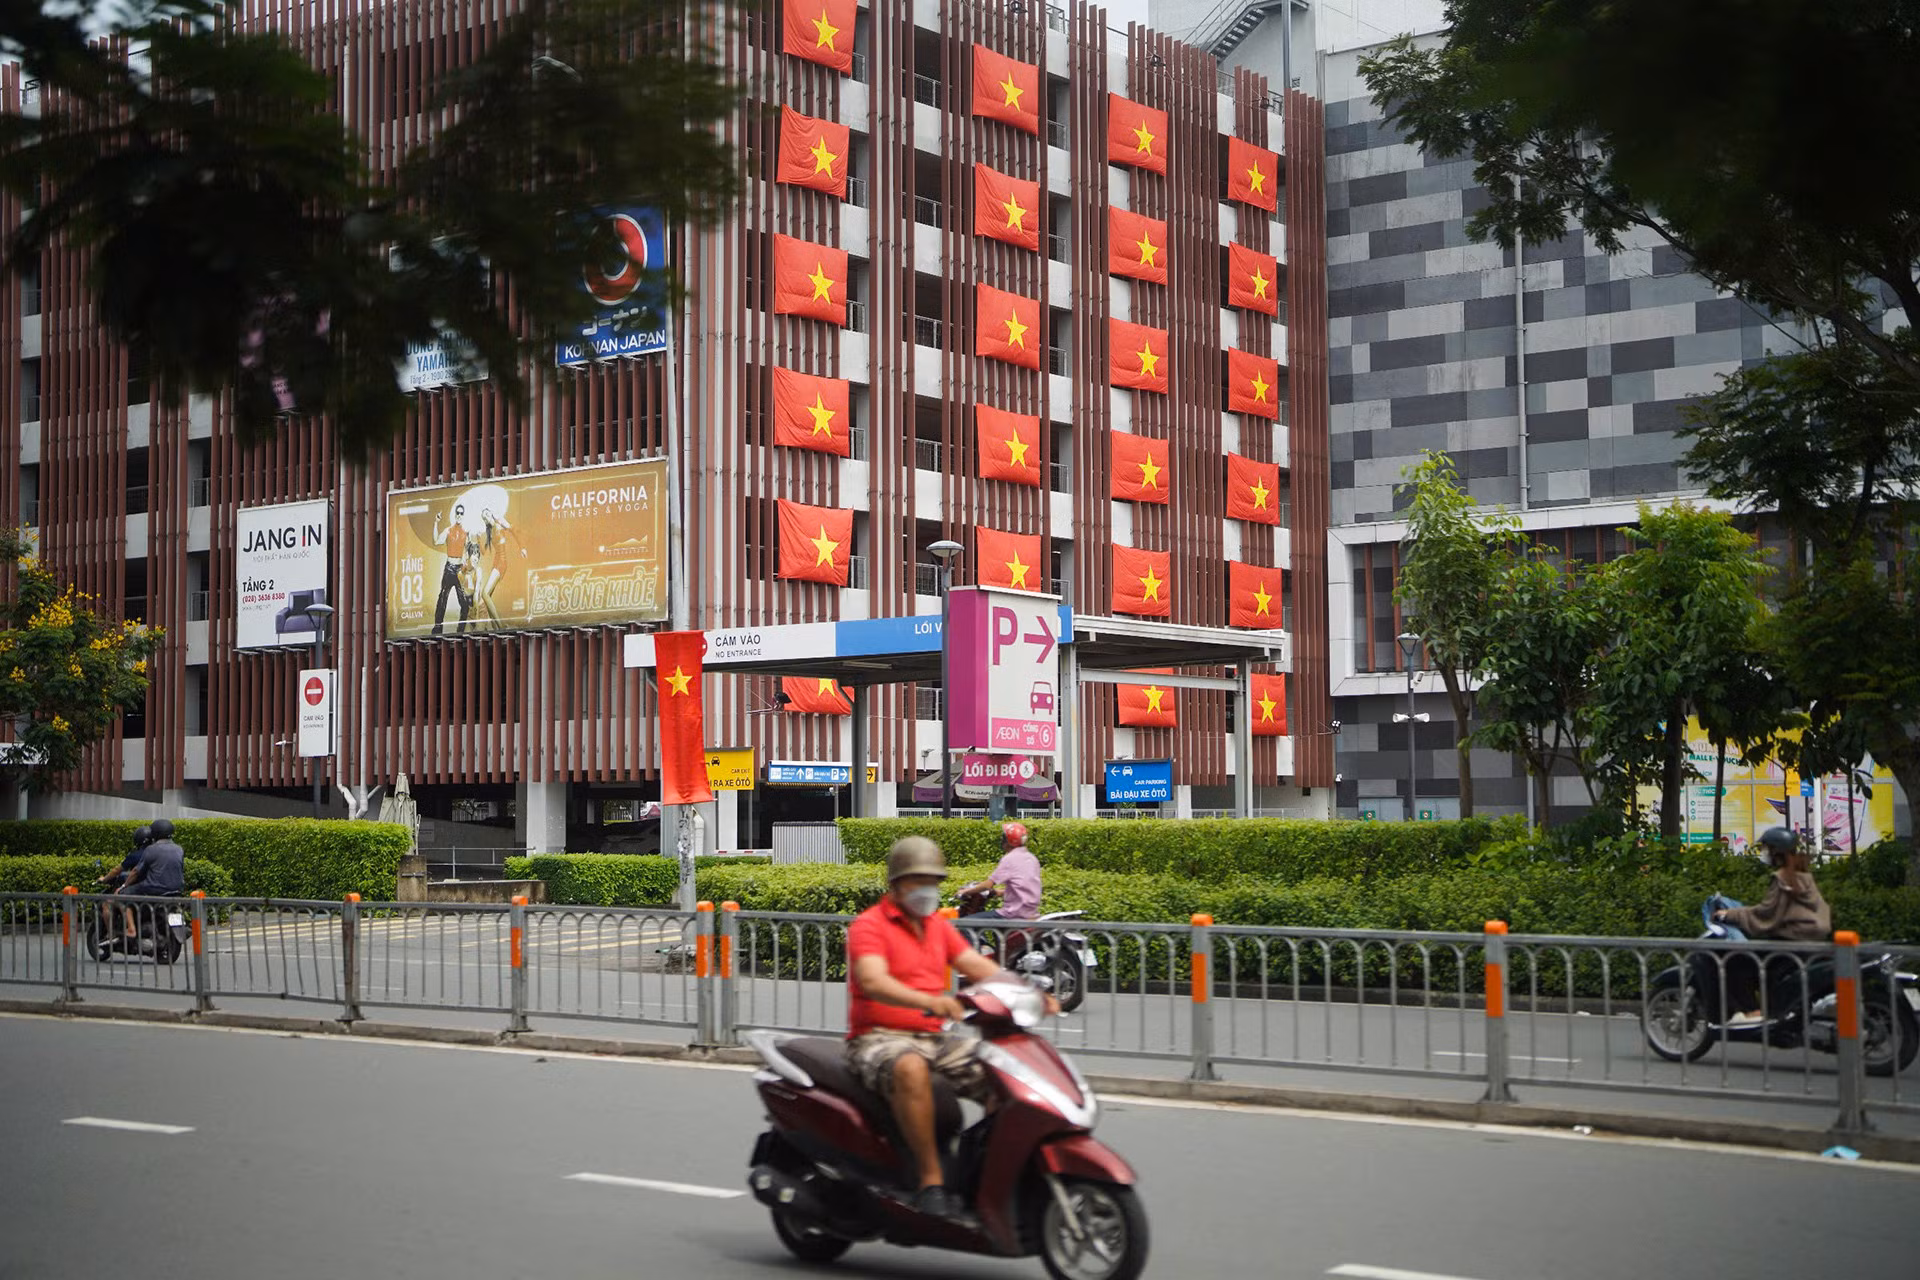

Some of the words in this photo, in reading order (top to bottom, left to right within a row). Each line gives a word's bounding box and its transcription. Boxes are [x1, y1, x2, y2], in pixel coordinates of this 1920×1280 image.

[620, 329, 665, 350] JAPAN
[551, 485, 648, 510] CALIFORNIA
[551, 507, 599, 521] FITNESS
[605, 505, 612, 514] &
[617, 502, 649, 513] YOGA
[243, 527, 296, 553] JANG
[302, 524, 322, 547] IN
[242, 576, 266, 593] TẦNG
[268, 579, 275, 591] 2
[401, 574, 423, 605] 03
[740, 632, 761, 646] VÀO
[992, 606, 1017, 666] P
[715, 650, 725, 658] NO
[727, 649, 761, 658] ENTRANCE
[1042, 729, 1049, 743] 6
[965, 762, 983, 777] LỐI
[985, 764, 997, 776] ĐI
[1000, 761, 1017, 779] BỘ
[713, 779, 723, 787] RA
[725, 779, 734, 787] XE
[1110, 790, 1122, 799] BÃI
[1140, 789, 1150, 798] XE
